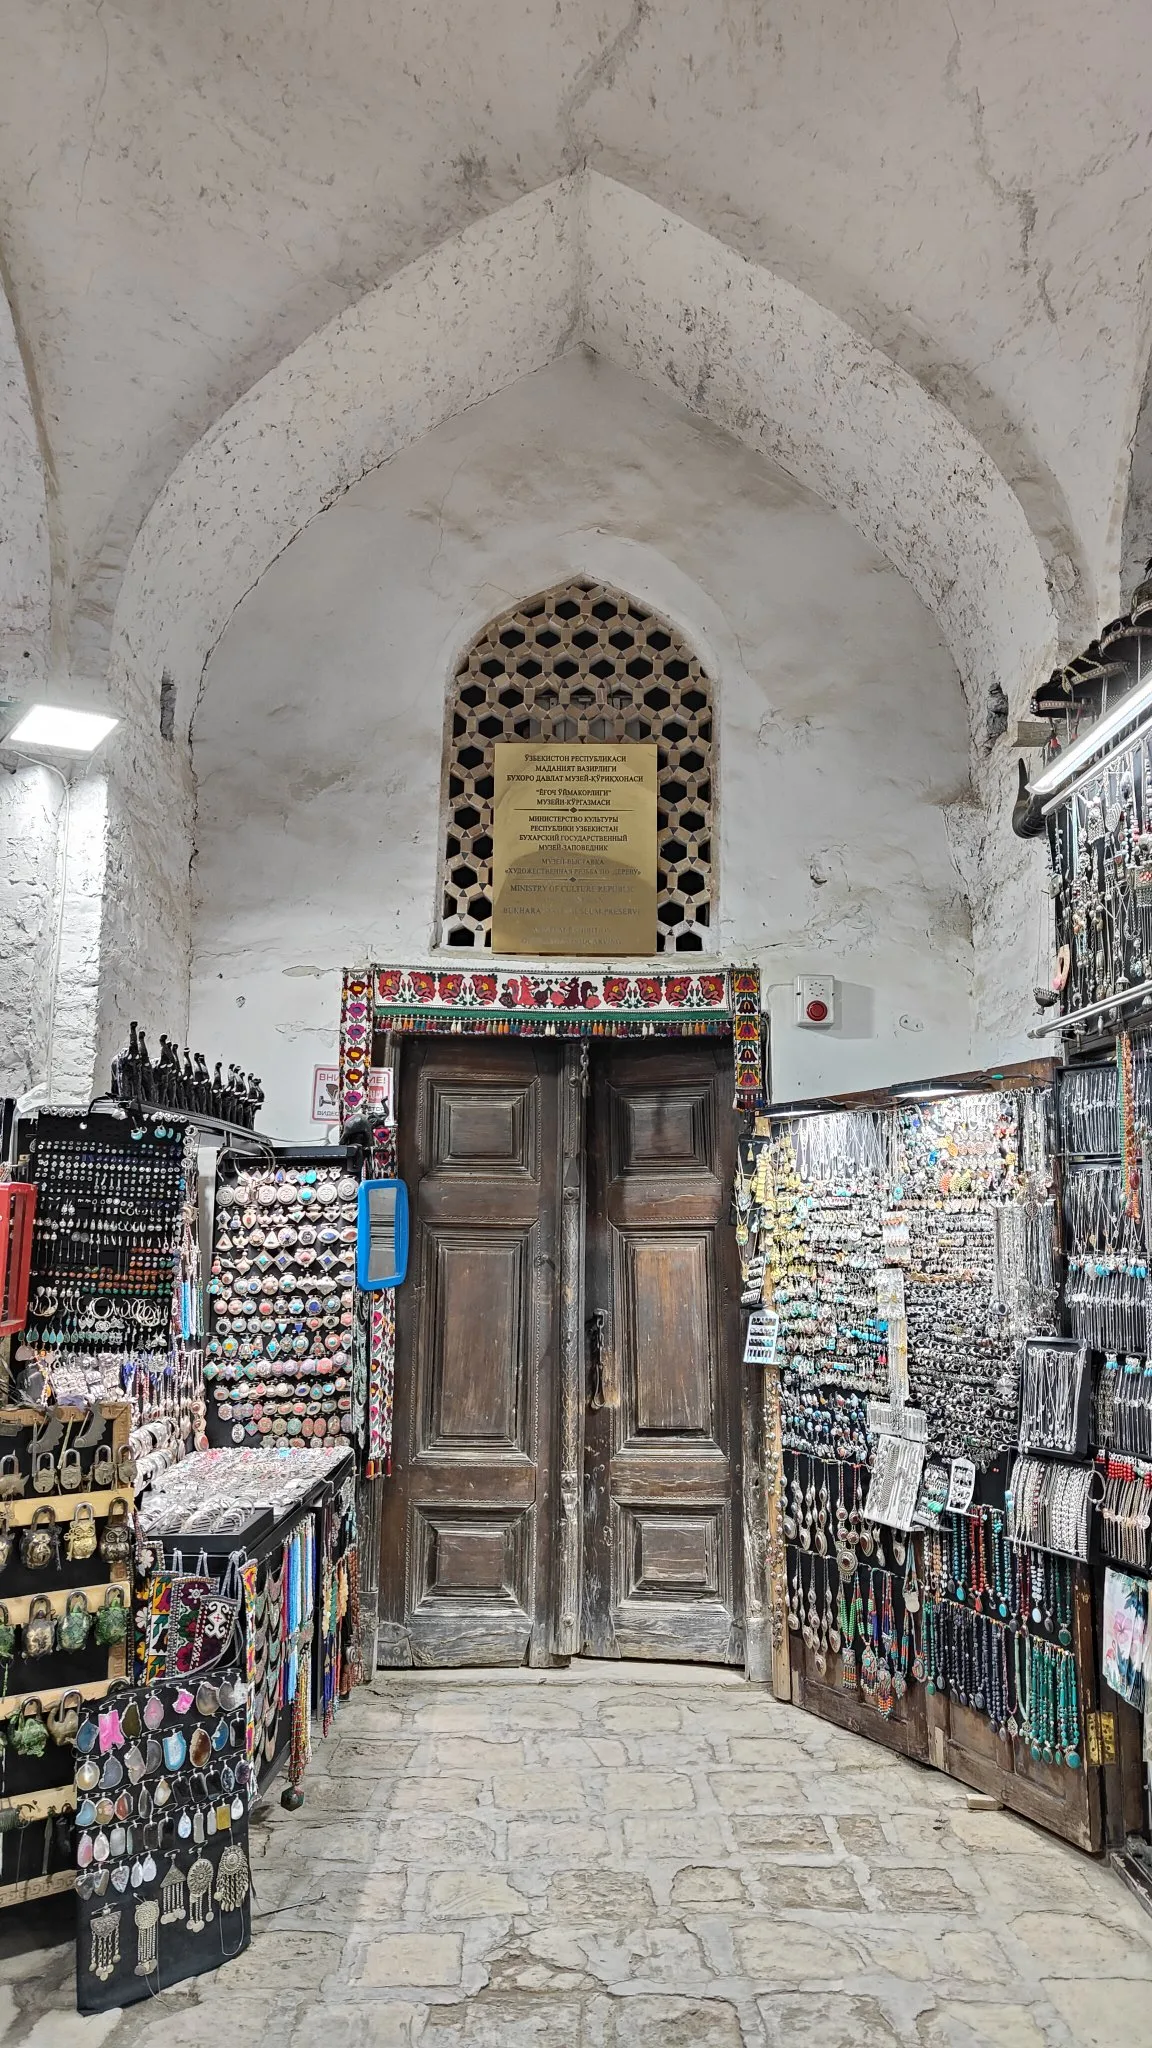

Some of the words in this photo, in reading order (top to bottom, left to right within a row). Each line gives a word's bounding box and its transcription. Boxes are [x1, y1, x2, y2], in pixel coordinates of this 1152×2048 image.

[524, 754, 570, 762] ЎЗБЕКИСТОН
[571, 755, 627, 763] РЕСПУБЛИКАСИ
[535, 765, 575, 773] МАДАНИЯТ
[577, 765, 617, 773] ВАЗИРЛИГИ
[506, 774, 535, 782] БУХОРО
[536, 775, 564, 783] ДАВЛАТ
[528, 815, 583, 823] МИНИСТЕРСТВО
[530, 825, 574, 833] РЕСПУБЛИКИ
[575, 825, 619, 833] УЗБЕКИСТАН
[519, 833, 560, 841] БУХАРСКИЙ
[560, 834, 628, 842] ГОСУДАРСТВЕННЫЙ
[510, 884, 546, 893] MINISTRY
